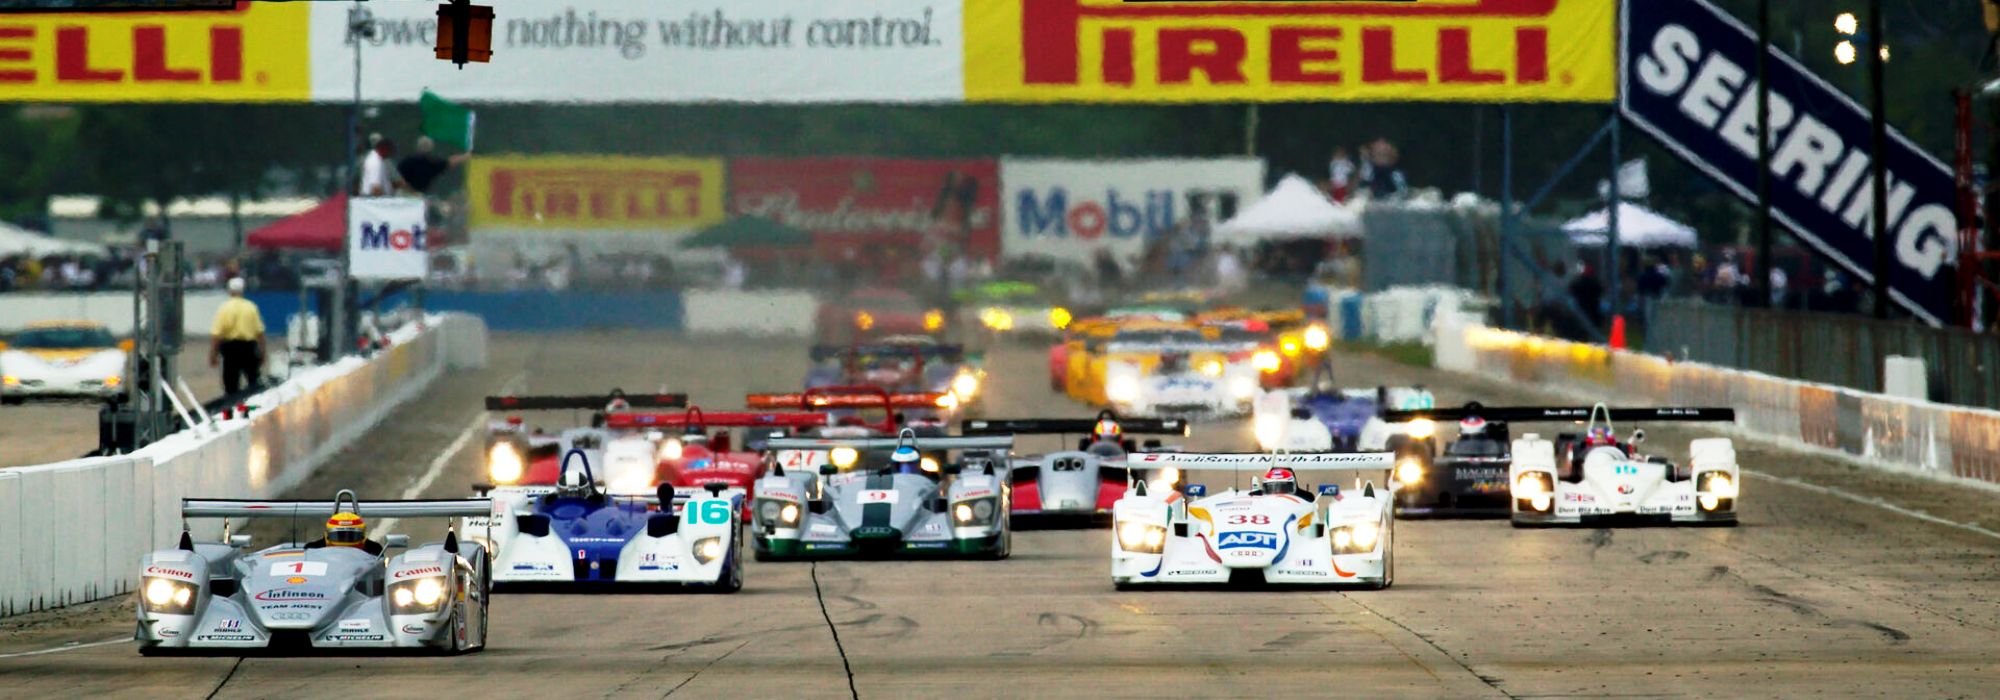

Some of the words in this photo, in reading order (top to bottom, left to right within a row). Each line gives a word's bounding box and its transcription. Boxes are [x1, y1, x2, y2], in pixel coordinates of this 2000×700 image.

[344, 7, 438, 46] Powe
[504, 7, 647, 60] nothing
[657, 9, 795, 50] without
[805, 7, 943, 48] control.
[1021, 0, 1558, 85] PIRELLI
[1636, 22, 1958, 280] SEBRING
[489, 167, 701, 218] PIRELLI
[1017, 188, 1173, 239] Mobil
[1309, 454, 1384, 463] America
[687, 500, 730, 525] 16
[1227, 514, 1271, 525] 38
[1219, 533, 1276, 547] ADT
[147, 566, 194, 579] Canon
[287, 562, 304, 573] 1
[394, 566, 442, 579] Canon
